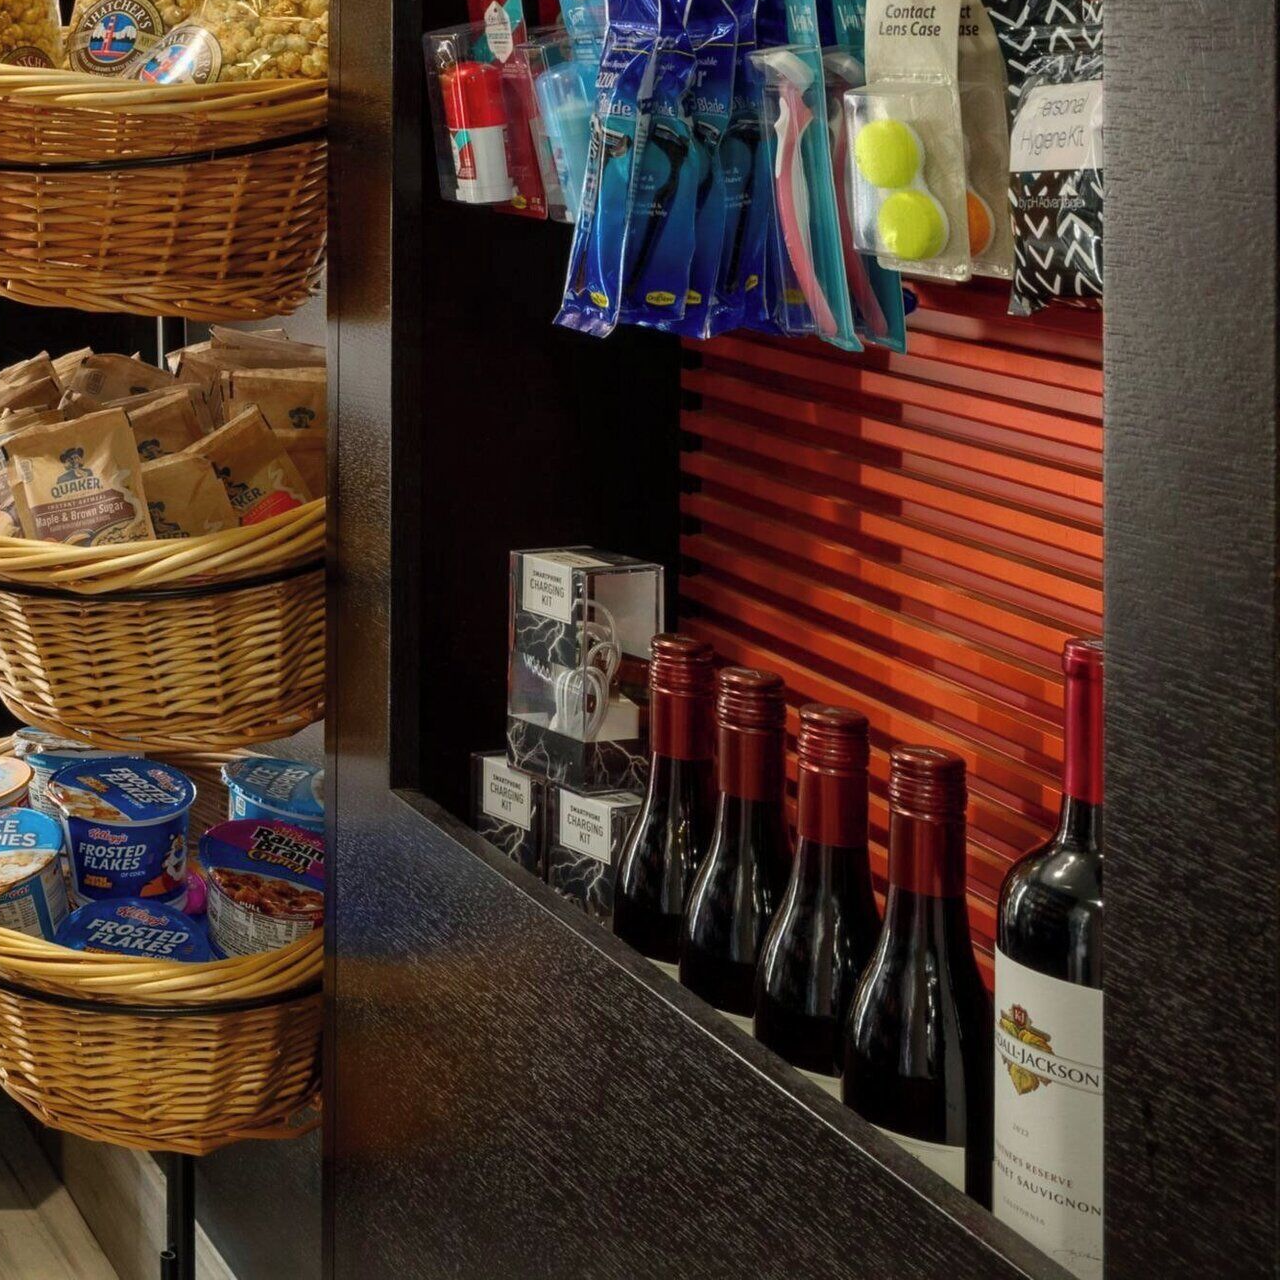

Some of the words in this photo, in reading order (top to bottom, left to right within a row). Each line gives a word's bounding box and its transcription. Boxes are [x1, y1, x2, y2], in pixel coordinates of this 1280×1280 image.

[885, 4, 936, 20] Contact
[879, 21, 907, 37] Lens
[910, 21, 941, 37] Case
[1034, 96, 1089, 118] Personal
[1021, 126, 1067, 156] Hygiene
[1069, 123, 1085, 147] Kit
[51, 477, 102, 499] QUAKER
[35, 511, 60, 528] Maple
[61, 511, 69, 522] &
[70, 507, 96, 521] Brown
[98, 502, 124, 517] Sugar
[532, 569, 563, 584] SMARTPHONE
[529, 580, 565, 598] CHARGING
[541, 595, 553, 608] KIT
[97, 770, 156, 806] FLAKES
[110, 766, 181, 806] FROSTED
[244, 765, 277, 791] RICE
[492, 773, 522, 791] SMARTPHONE
[489, 783, 524, 805] CHARGING
[501, 799, 513, 813] KIT
[569, 804, 601, 822] SMARTPHONE
[88, 827, 129, 844] Kellogg's
[566, 815, 604, 838] CHARGING
[252, 824, 324, 863] Raisin
[578, 831, 591, 846] KIT
[78, 841, 147, 861] FROSTED
[246, 848, 306, 876] Crunch
[258, 839, 314, 870] Bran
[83, 856, 141, 872] FLAKES
[116, 905, 169, 927] Kellogg's
[85, 918, 191, 945] FROSTED
[90, 930, 175, 954] FLAKES
[1025, 1160, 1074, 1189] RESERVE
[1017, 1178, 1102, 1217] SAUVIGNON
